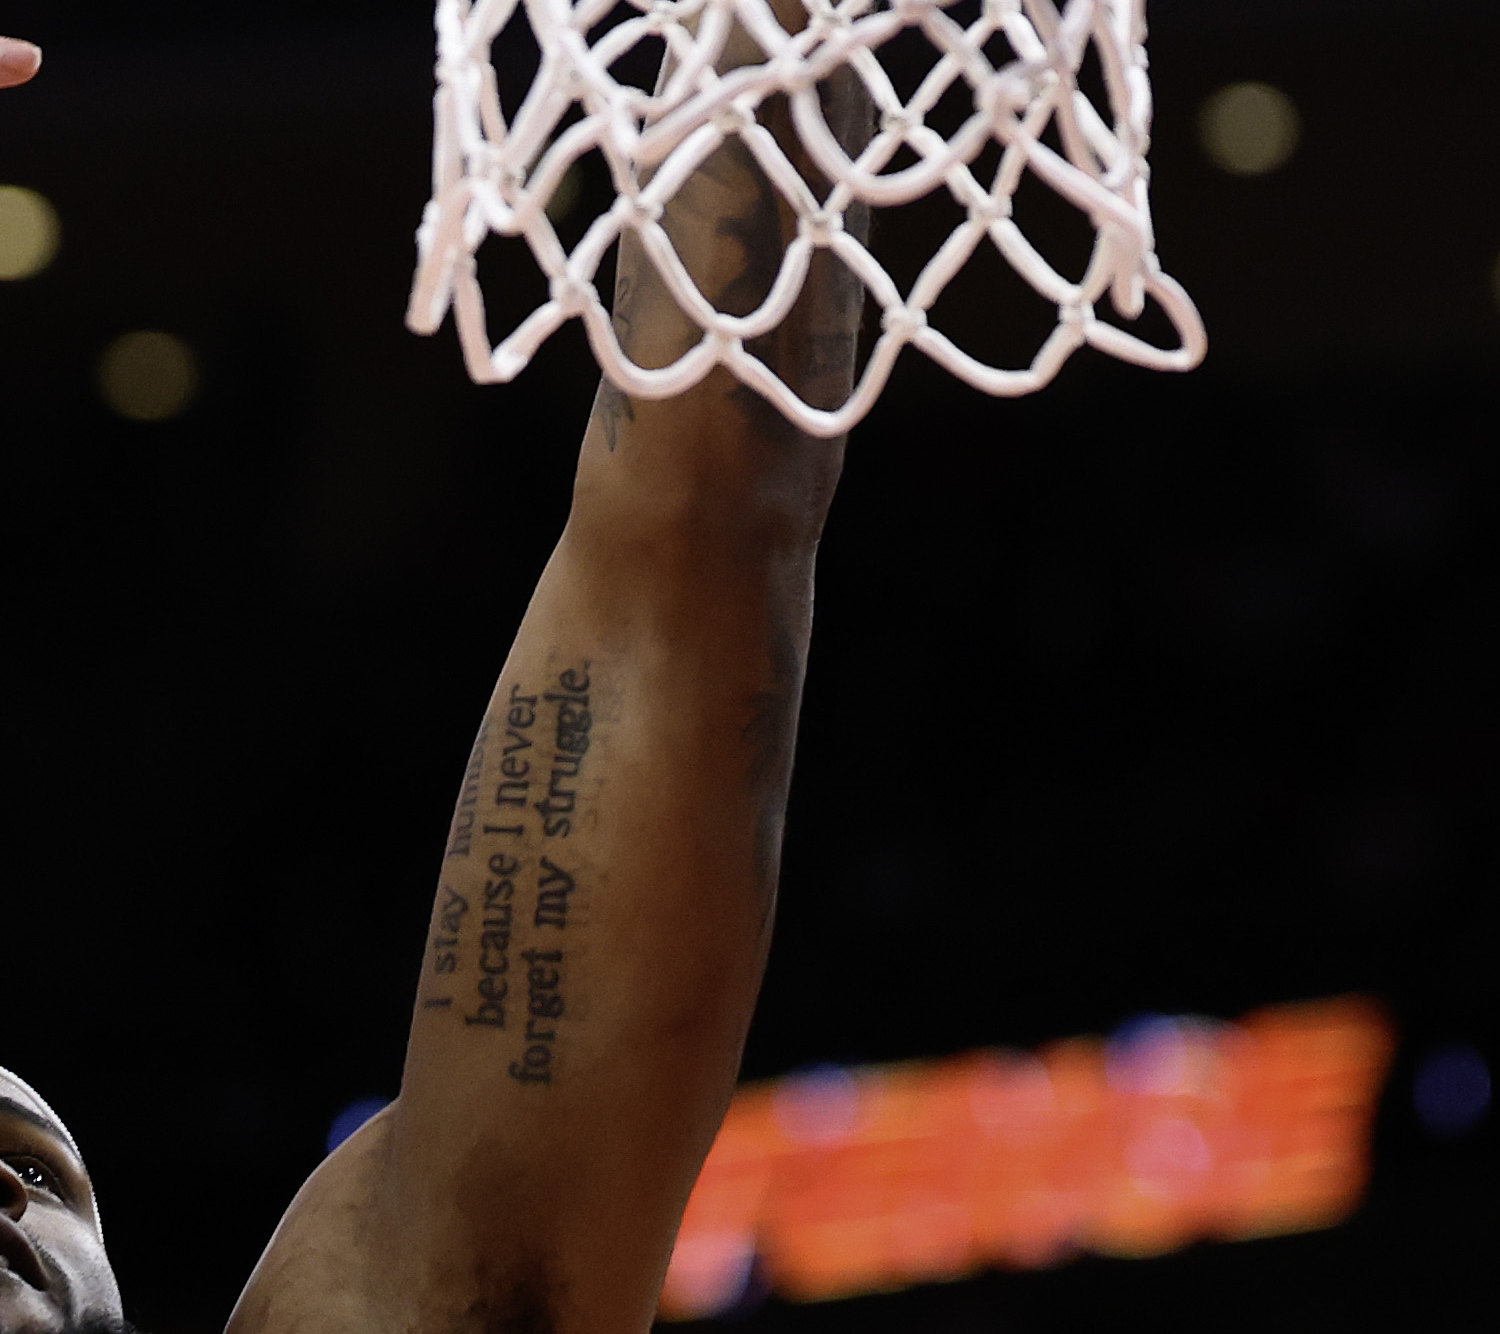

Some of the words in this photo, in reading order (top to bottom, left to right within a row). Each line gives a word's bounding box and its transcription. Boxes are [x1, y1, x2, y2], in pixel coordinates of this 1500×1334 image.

[496, 683, 539, 808] never
[484, 823, 524, 838] I
[434, 884, 469, 976] stay
[465, 853, 519, 1030] because
[534, 856, 576, 930] my
[508, 947, 565, 1087] forget
